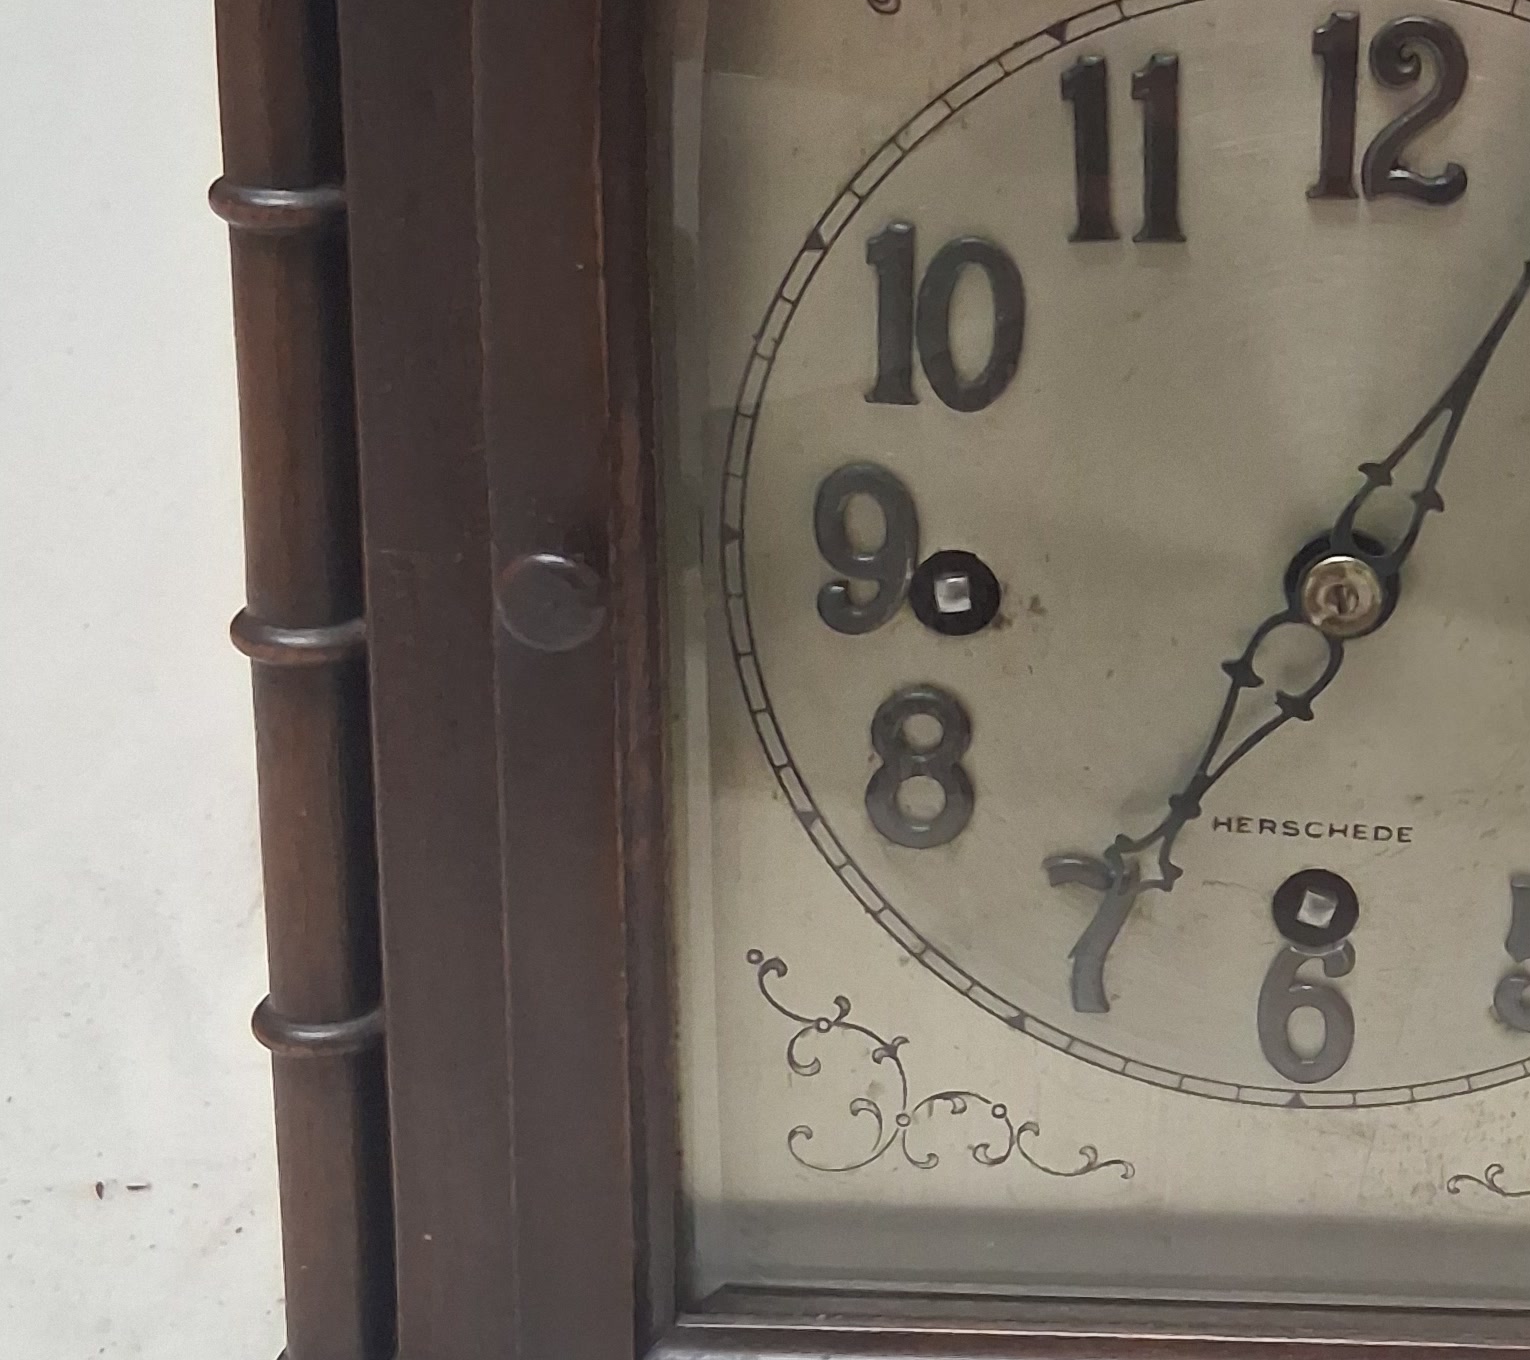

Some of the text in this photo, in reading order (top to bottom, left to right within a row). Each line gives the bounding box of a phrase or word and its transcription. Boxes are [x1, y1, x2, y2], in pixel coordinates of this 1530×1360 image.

[1060, 53, 1187, 243] 11
[1307, 11, 1468, 205] 12
[865, 222, 1026, 413] 10
[814, 462, 921, 635] 9
[865, 683, 974, 849] 8
[1213, 816, 1414, 843] HERSCHEDE
[1042, 851, 1142, 1014] 7
[1257, 938, 1356, 1084] 6
